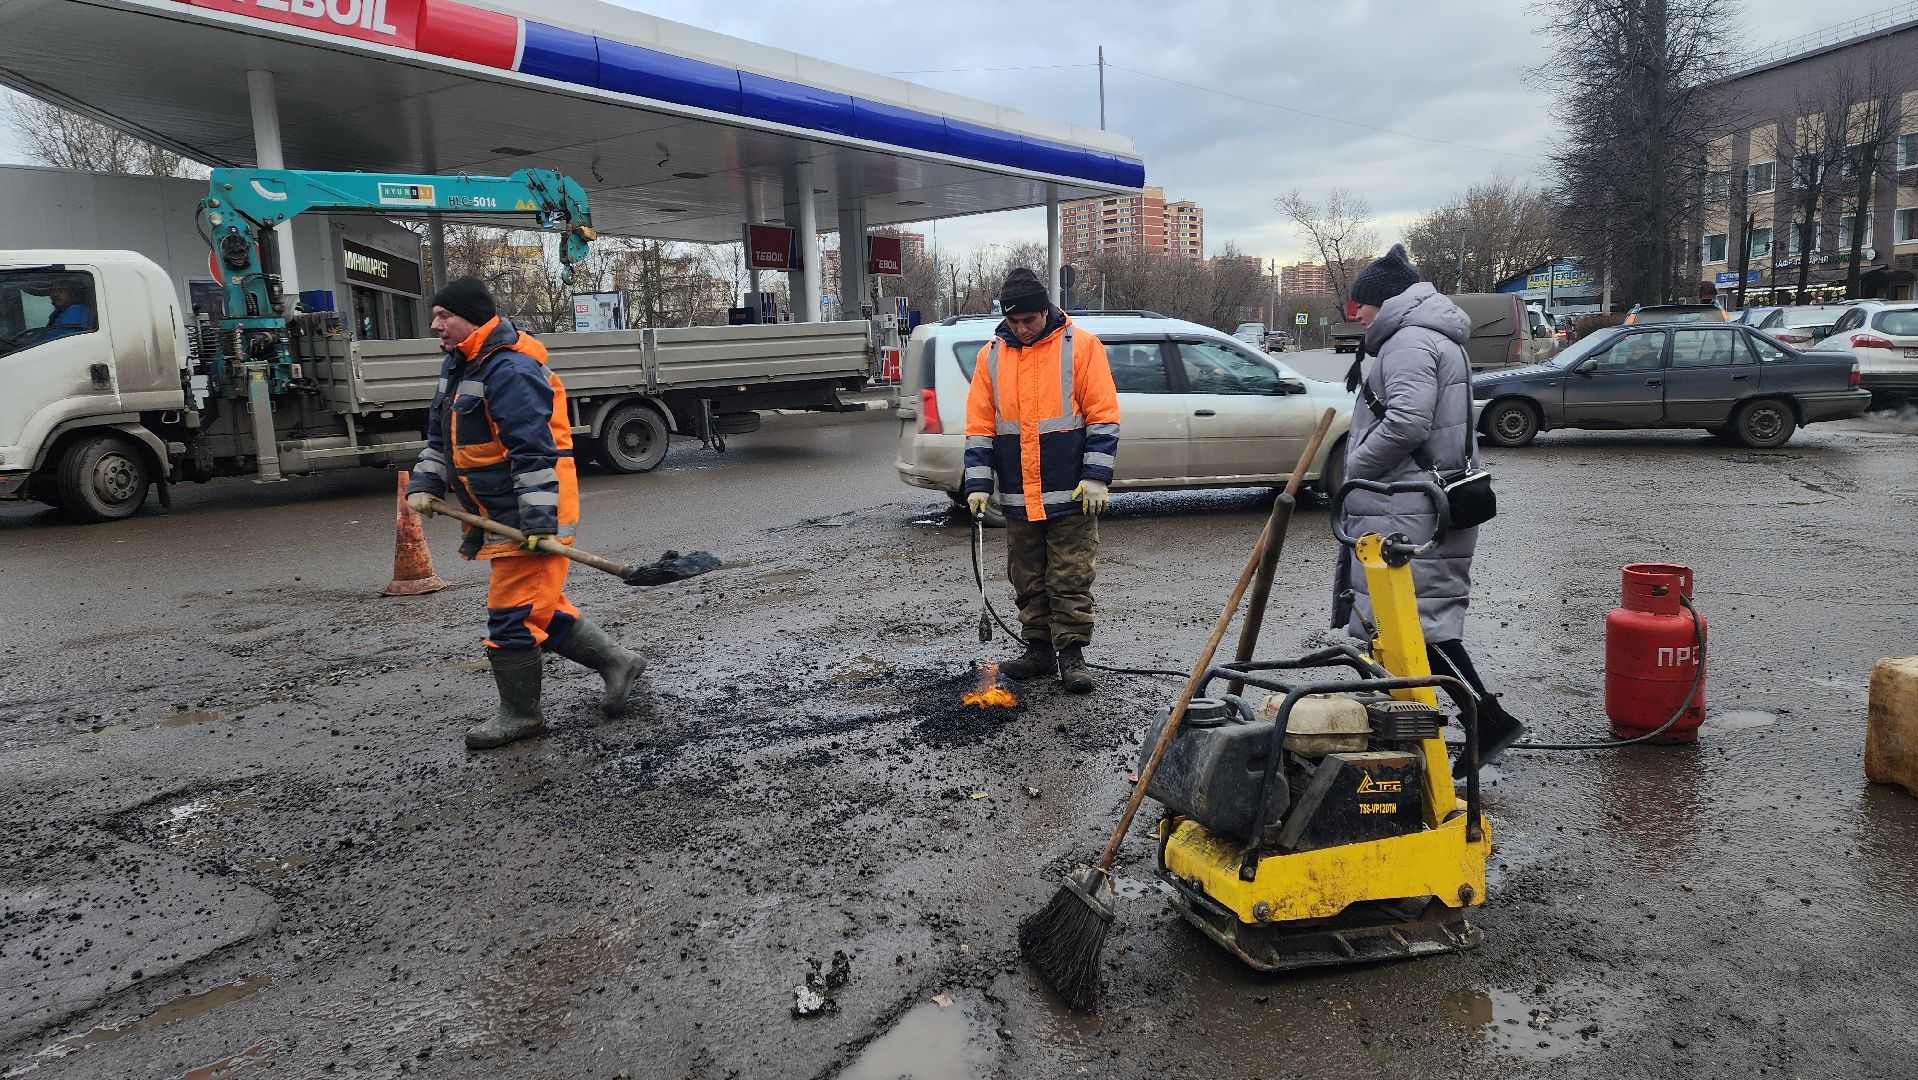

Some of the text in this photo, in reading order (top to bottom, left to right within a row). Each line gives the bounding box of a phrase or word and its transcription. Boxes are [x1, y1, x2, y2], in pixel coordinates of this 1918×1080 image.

[448, 196, 497, 207] HLC-5014
[755, 250, 784, 262] TEBOIL
[344, 249, 389, 279] МИНИМАРКЕТ
[1359, 803, 1397, 815] TSS-VP120TH
